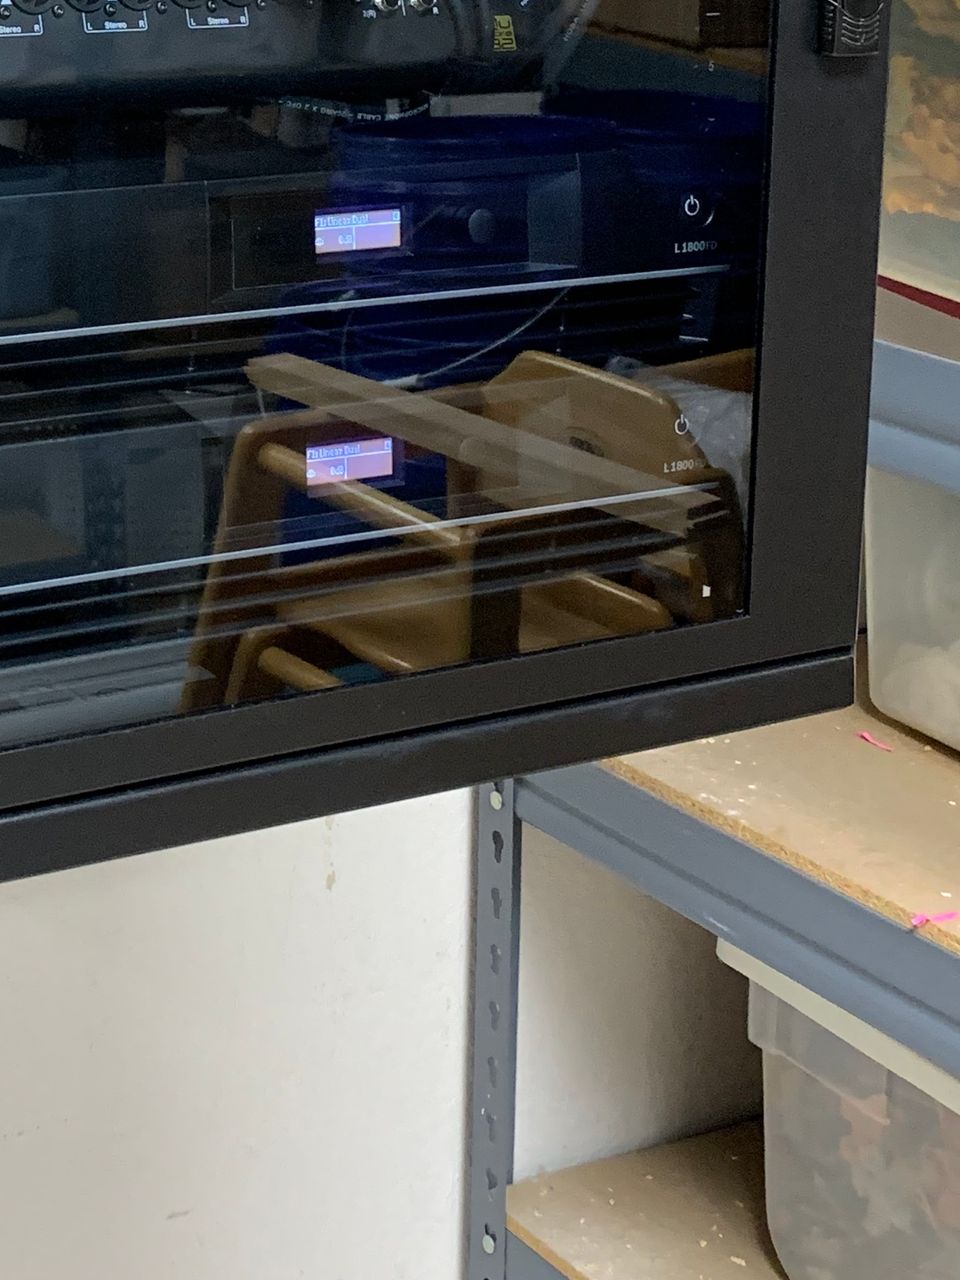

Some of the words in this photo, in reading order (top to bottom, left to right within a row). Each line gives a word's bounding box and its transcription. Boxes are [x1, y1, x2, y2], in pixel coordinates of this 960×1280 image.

[87, 22, 93, 30] L
[104, 21, 128, 30] Stereo
[139, 20, 145, 28] R
[191, 18, 196, 26] L
[207, 17, 230, 25] Stereo
[240, 16, 247, 24] R
[33, 24, 40, 32] R
